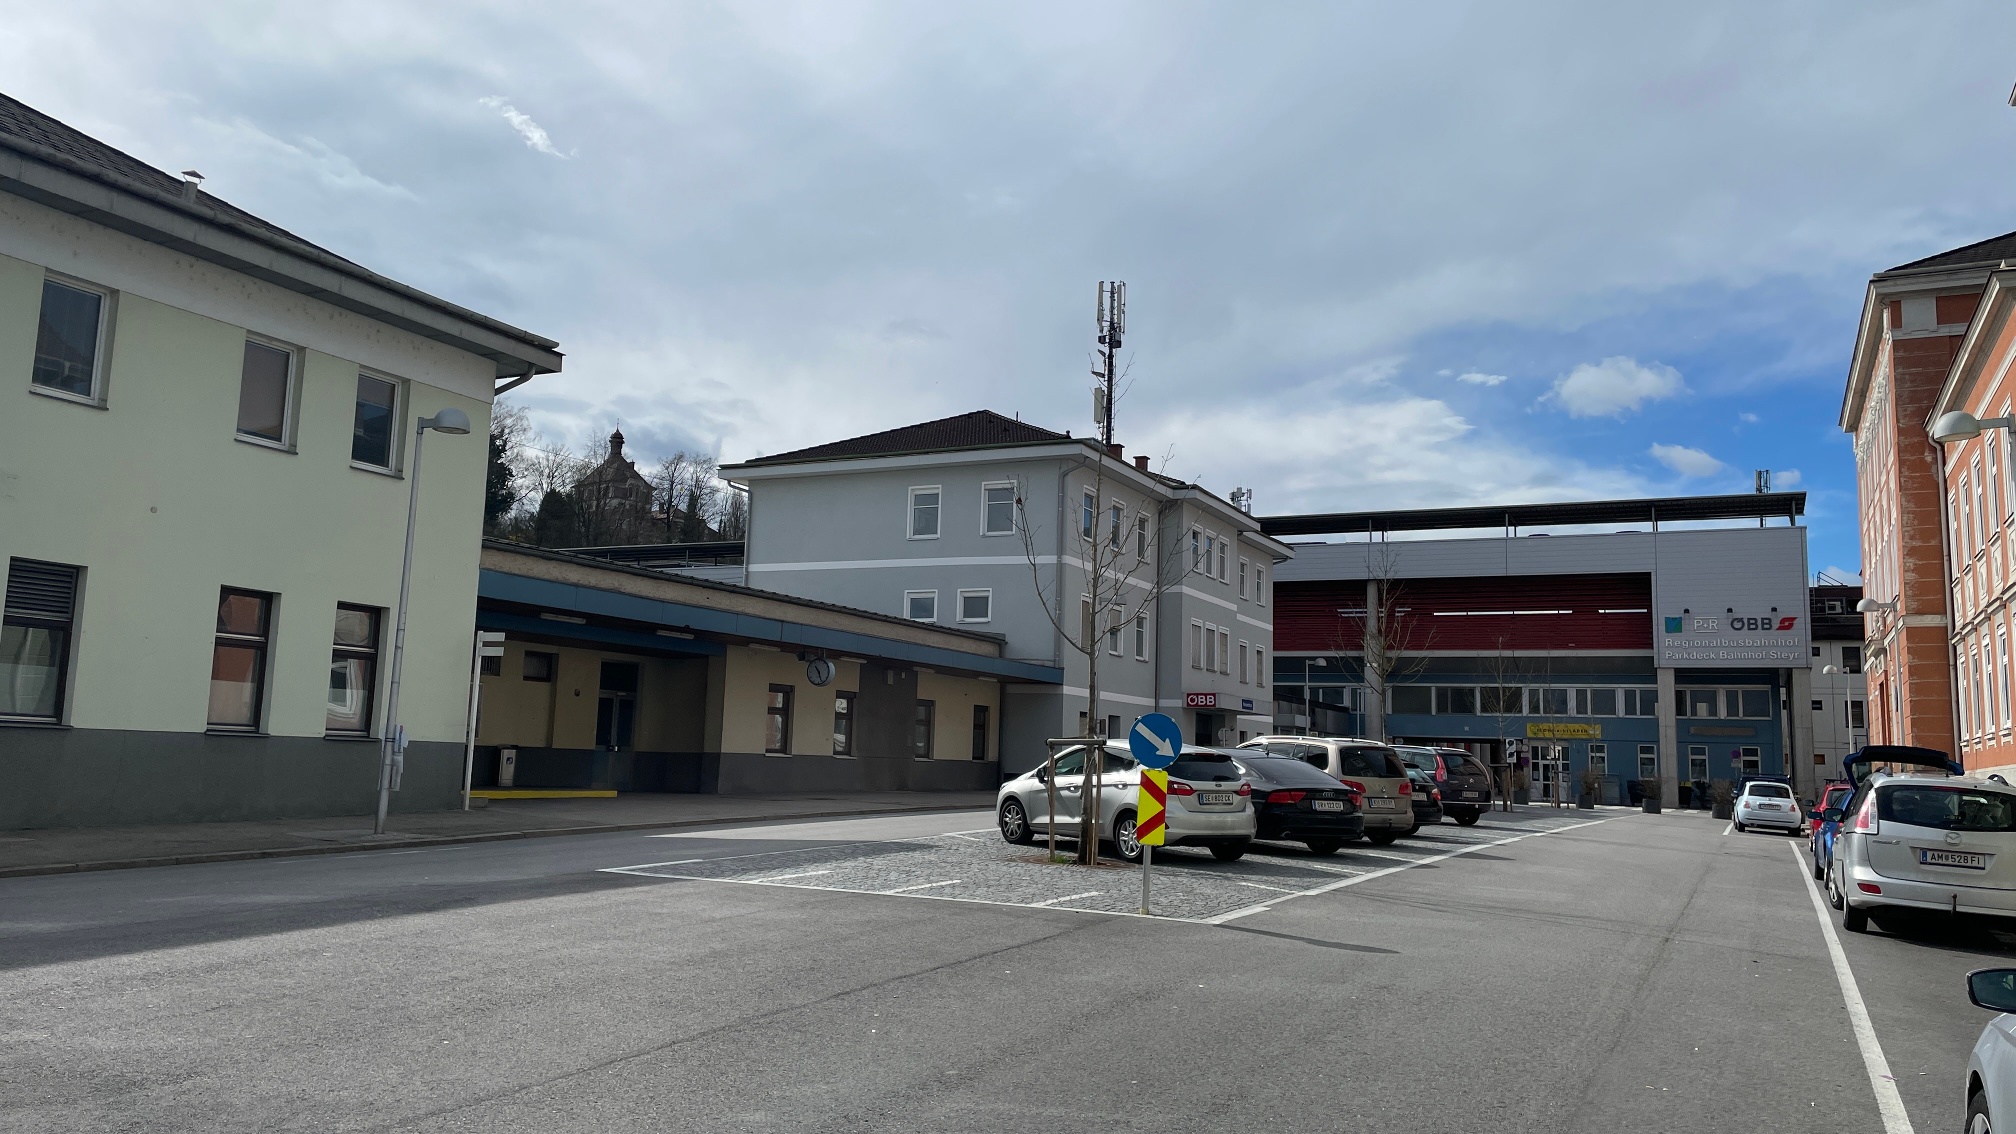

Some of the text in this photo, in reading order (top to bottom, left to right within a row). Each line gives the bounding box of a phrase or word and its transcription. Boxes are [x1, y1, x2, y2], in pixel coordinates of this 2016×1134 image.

[1694, 617, 1773, 631] P+R ÖBB
[1665, 638, 1800, 649] Regionalbusbahnhof
[1665, 650, 1800, 660] Parkdeck Bahnhof Steyr
[1187, 694, 1215, 706] ÖBB
